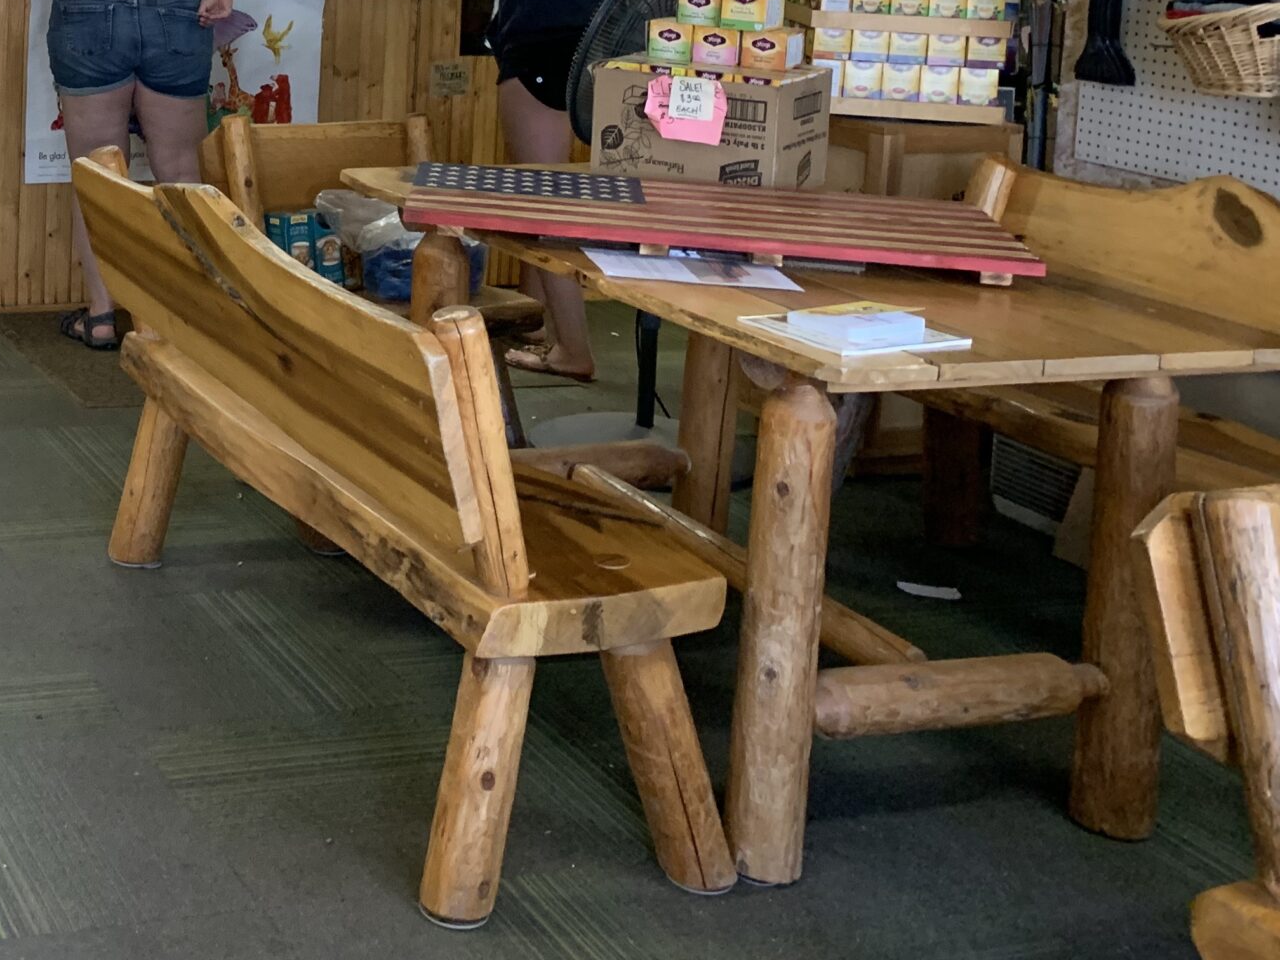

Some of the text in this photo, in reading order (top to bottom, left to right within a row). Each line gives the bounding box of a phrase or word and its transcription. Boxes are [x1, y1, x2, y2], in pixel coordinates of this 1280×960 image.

[679, 80, 703, 93] SALE!
[675, 104, 702, 115] EACH!
[732, 139, 749, 148] Poly
[38, 151, 48, 160] Be
[49, 151, 66, 162] glad
